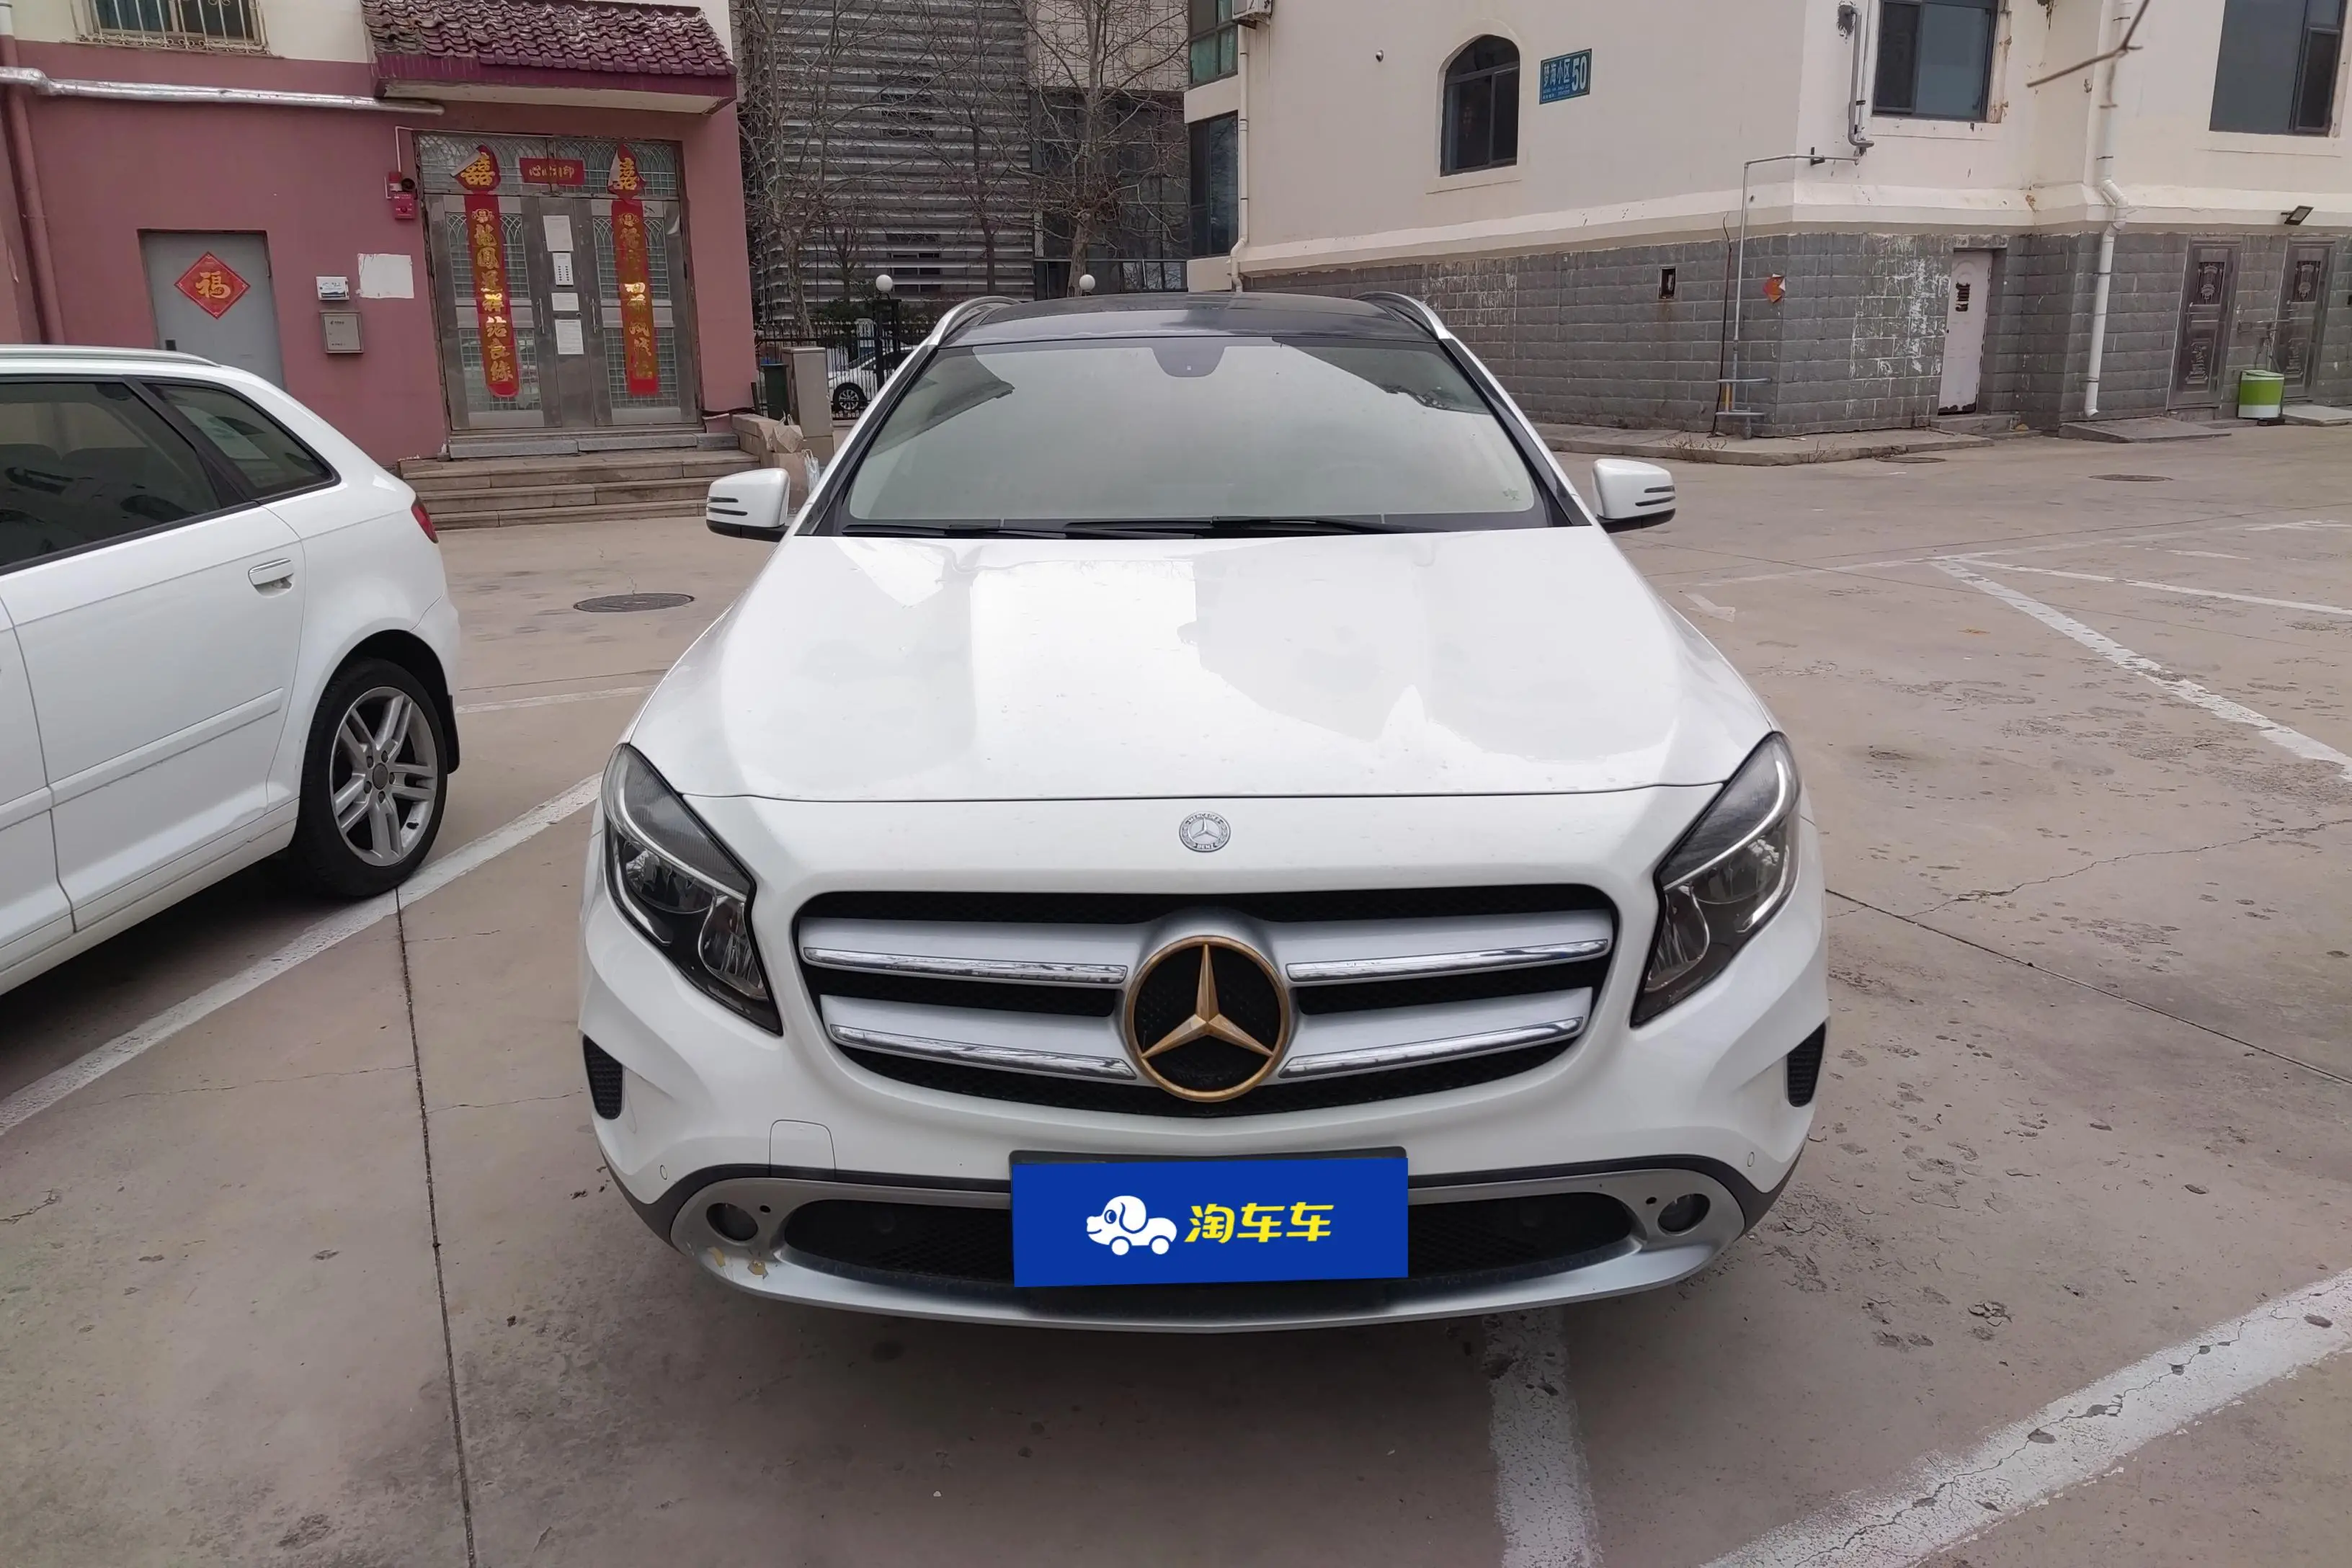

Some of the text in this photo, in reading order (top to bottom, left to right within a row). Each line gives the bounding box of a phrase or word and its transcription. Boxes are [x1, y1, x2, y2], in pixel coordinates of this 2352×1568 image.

[1543, 58, 1571, 87] 梦海小区
[1571, 55, 1587, 92] 50
[195, 270, 231, 299] 福
